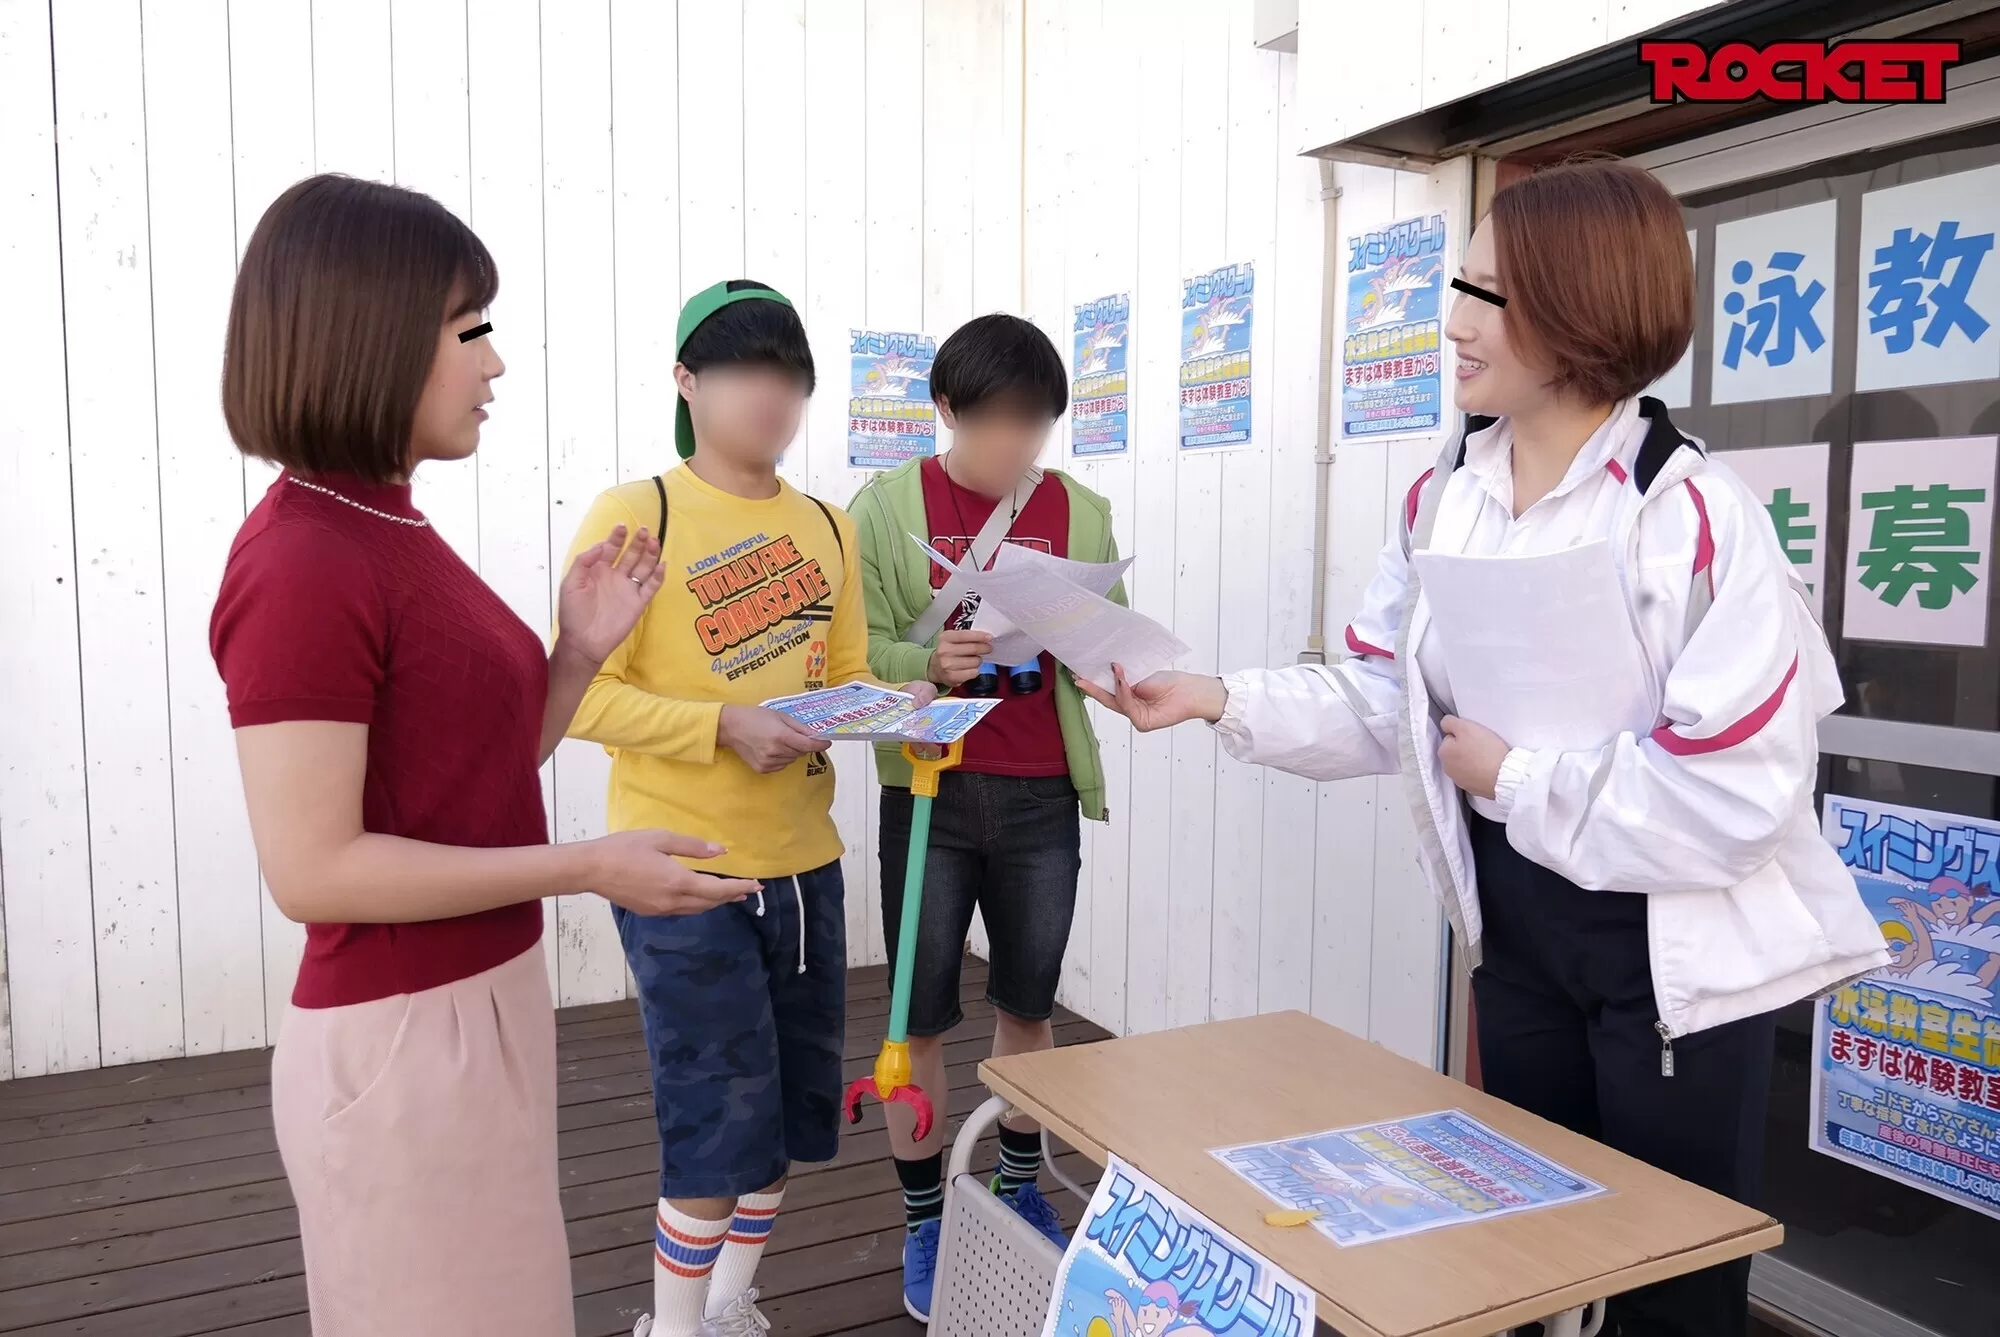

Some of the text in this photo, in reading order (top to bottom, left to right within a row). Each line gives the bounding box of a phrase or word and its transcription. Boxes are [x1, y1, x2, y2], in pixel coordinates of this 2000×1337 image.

[1348, 214, 1445, 273] スイミングスクール
[1183, 263, 1254, 309] スイミングスクール
[1722, 220, 1995, 371] 泳教
[850, 330, 936, 359] スイミングスクール
[686, 532, 769, 575] LOOK HOPEFUL
[687, 534, 804, 609] TOTALLY FINE
[695, 558, 832, 656] CORUSCATE
[711, 616, 814, 674] Further Progress
[726, 630, 811, 682] EFFECTUATION
